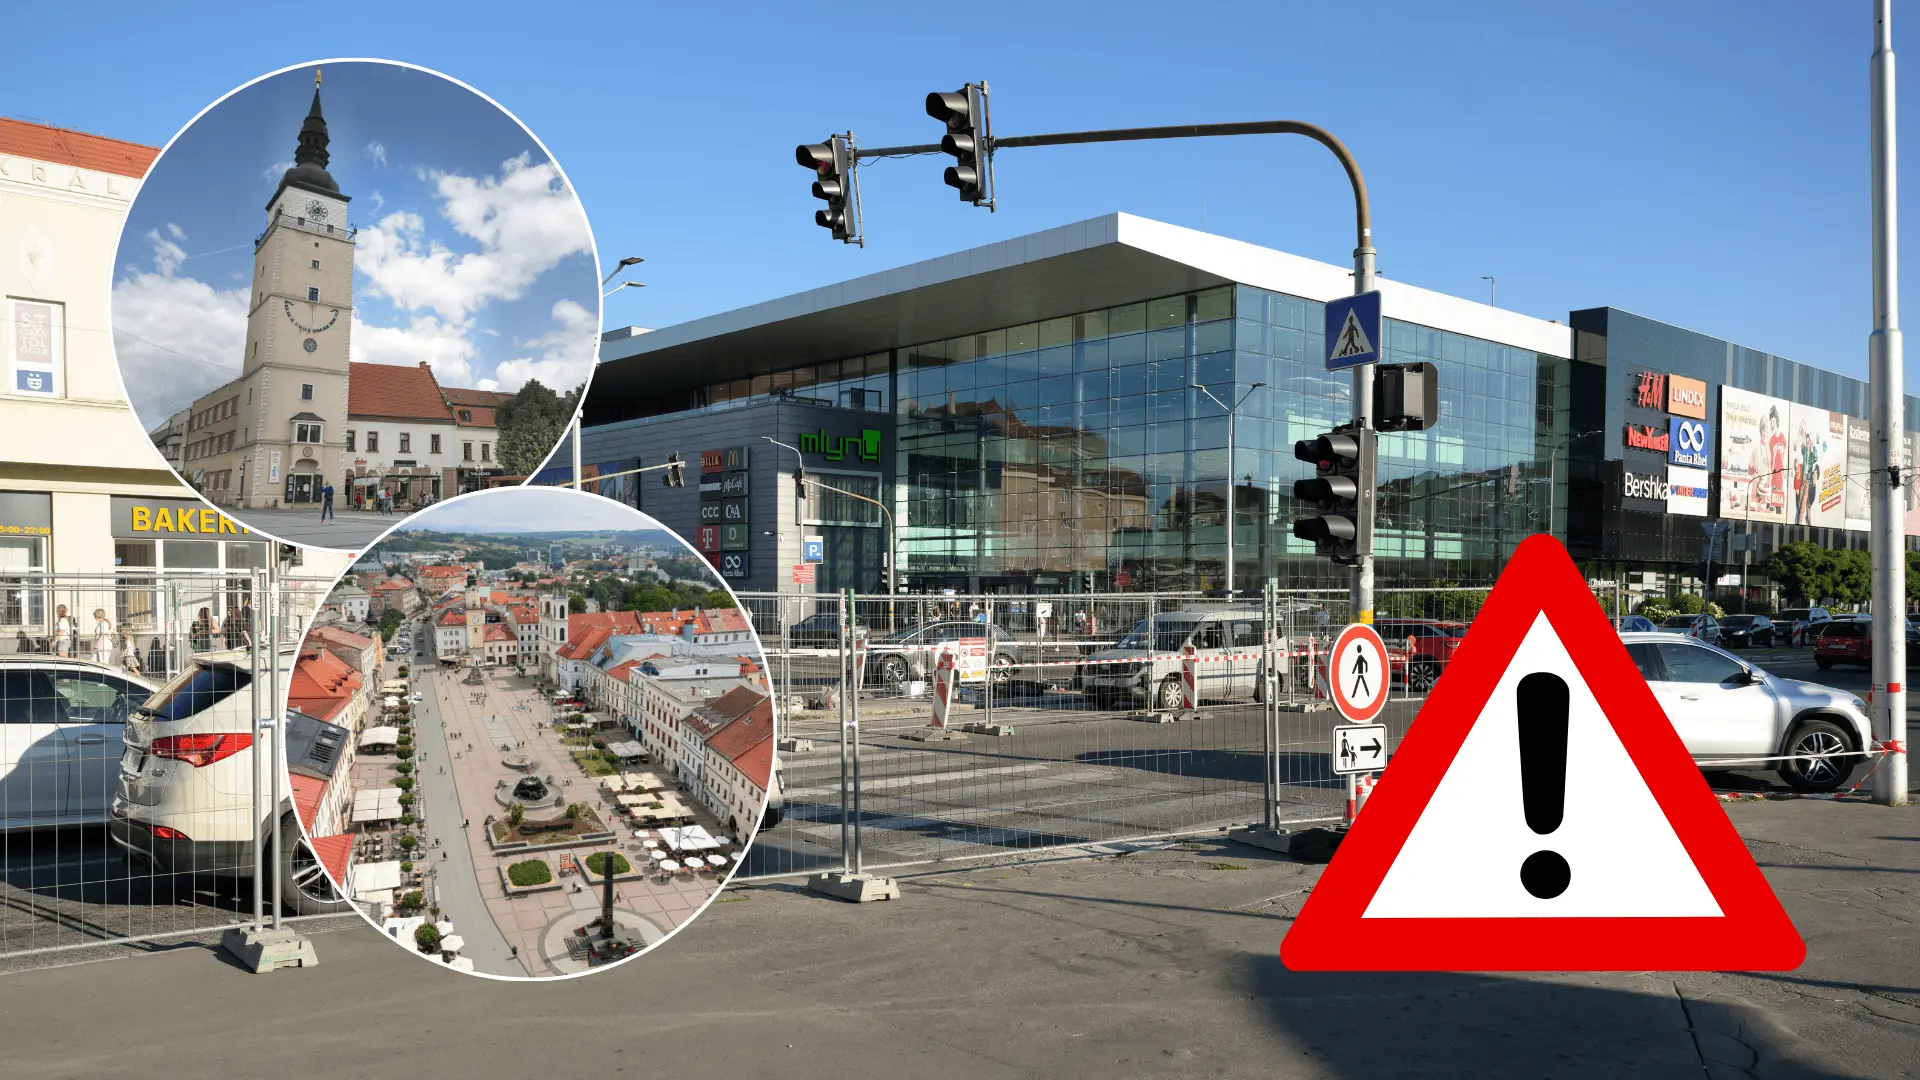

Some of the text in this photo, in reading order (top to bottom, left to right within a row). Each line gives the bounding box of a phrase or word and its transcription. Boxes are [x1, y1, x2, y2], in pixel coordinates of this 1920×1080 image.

[20, 336, 48, 348] TOL
[1637, 370, 1664, 411] H&M
[701, 455, 720, 467] BILLA
[1675, 450, 1707, 467] Panta Rhei
[1625, 472, 1669, 500] Bershka
[702, 507, 719, 518] CCC
[725, 504, 741, 518] C&A
[132, 506, 250, 535] BAKER
[809, 544, 818, 557] P
